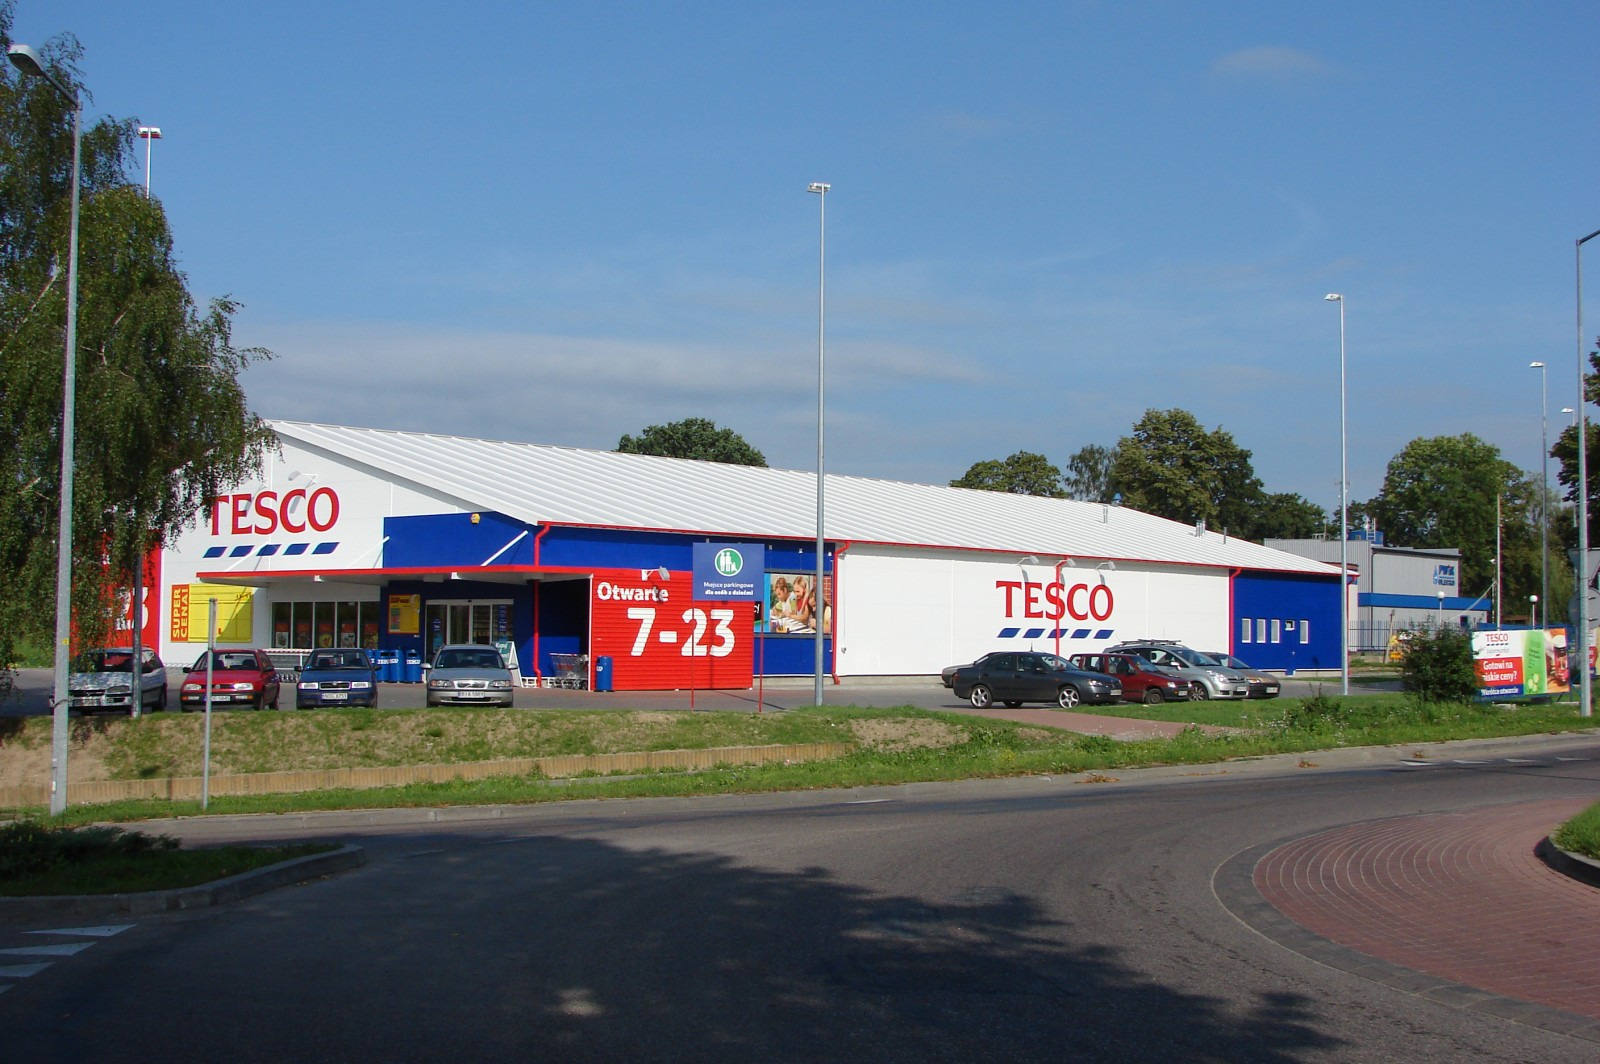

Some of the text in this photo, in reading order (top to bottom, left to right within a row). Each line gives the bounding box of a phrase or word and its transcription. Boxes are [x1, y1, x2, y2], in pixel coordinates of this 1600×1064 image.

[204, 487, 339, 535] TESCO
[597, 582, 669, 602] Otwarte
[996, 580, 1114, 621] TESCO
[173, 588, 181, 638] SUPER
[627, 607, 735, 657] 7-23
[1485, 633, 1509, 642] TESCO
[1483, 660, 1514, 670] Gotowi na
[1500, 670, 1517, 682] ceny?
